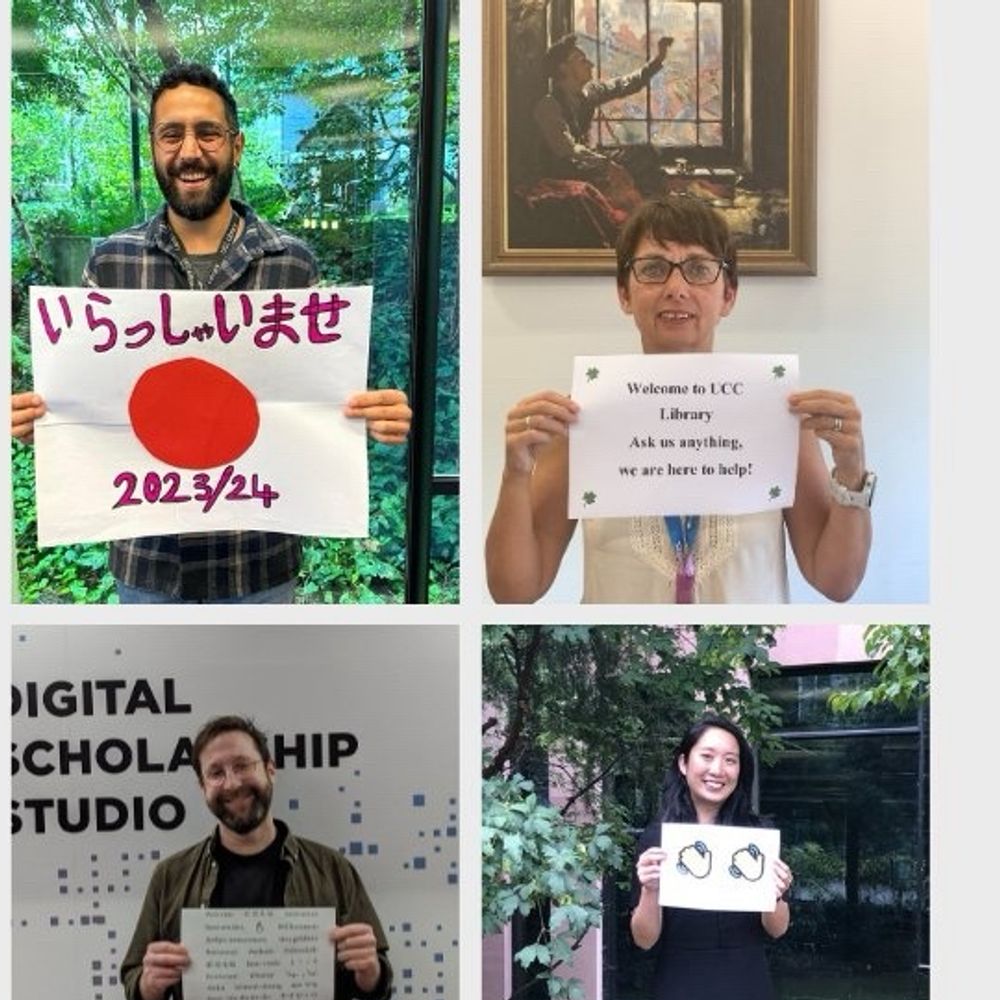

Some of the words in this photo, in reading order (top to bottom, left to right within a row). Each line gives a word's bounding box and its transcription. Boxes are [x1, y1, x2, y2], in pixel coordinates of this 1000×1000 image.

[37, 292, 352, 354] いらっしゃいませ
[627, 382, 689, 395] Welcome
[692, 383, 706, 395] to
[710, 382, 744, 395] UCC
[660, 408, 713, 423] Library
[630, 436, 655, 448] Ask
[660, 438, 675, 448] us
[619, 466, 637, 476] we
[641, 465, 664, 476] are
[667, 464, 698, 476] here
[701, 464, 715, 475] to
[718, 463, 753, 478] help!
[112, 465, 280, 514] 2023/24
[12, 678, 192, 718] IGITAL
